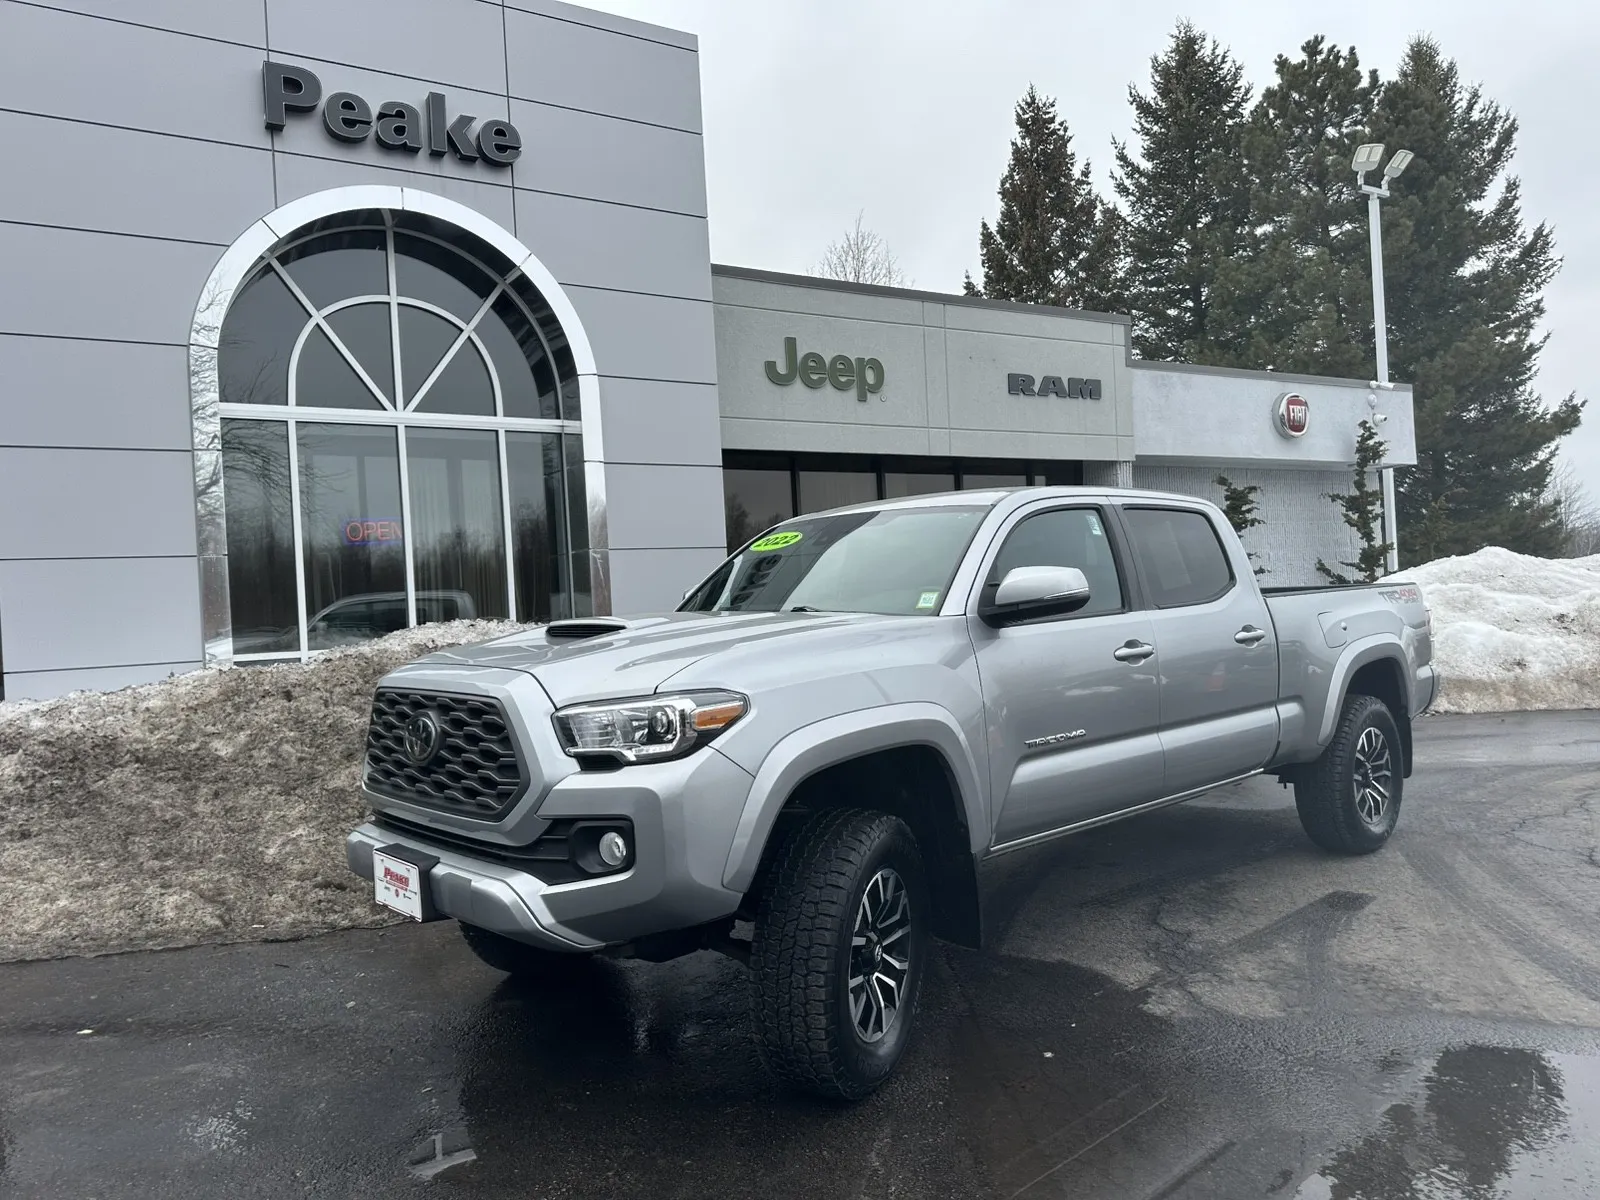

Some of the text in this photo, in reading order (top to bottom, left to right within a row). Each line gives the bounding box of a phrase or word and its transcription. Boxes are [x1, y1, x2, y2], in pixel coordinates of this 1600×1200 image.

[262, 61, 522, 167] Peake
[764, 336, 885, 401] Jeep
[1007, 373, 1102, 401] RAM
[1289, 405, 1306, 426] FIAT
[346, 521, 402, 541] OPEN
[753, 534, 799, 548] 2022
[1024, 729, 1086, 748] TACOMA
